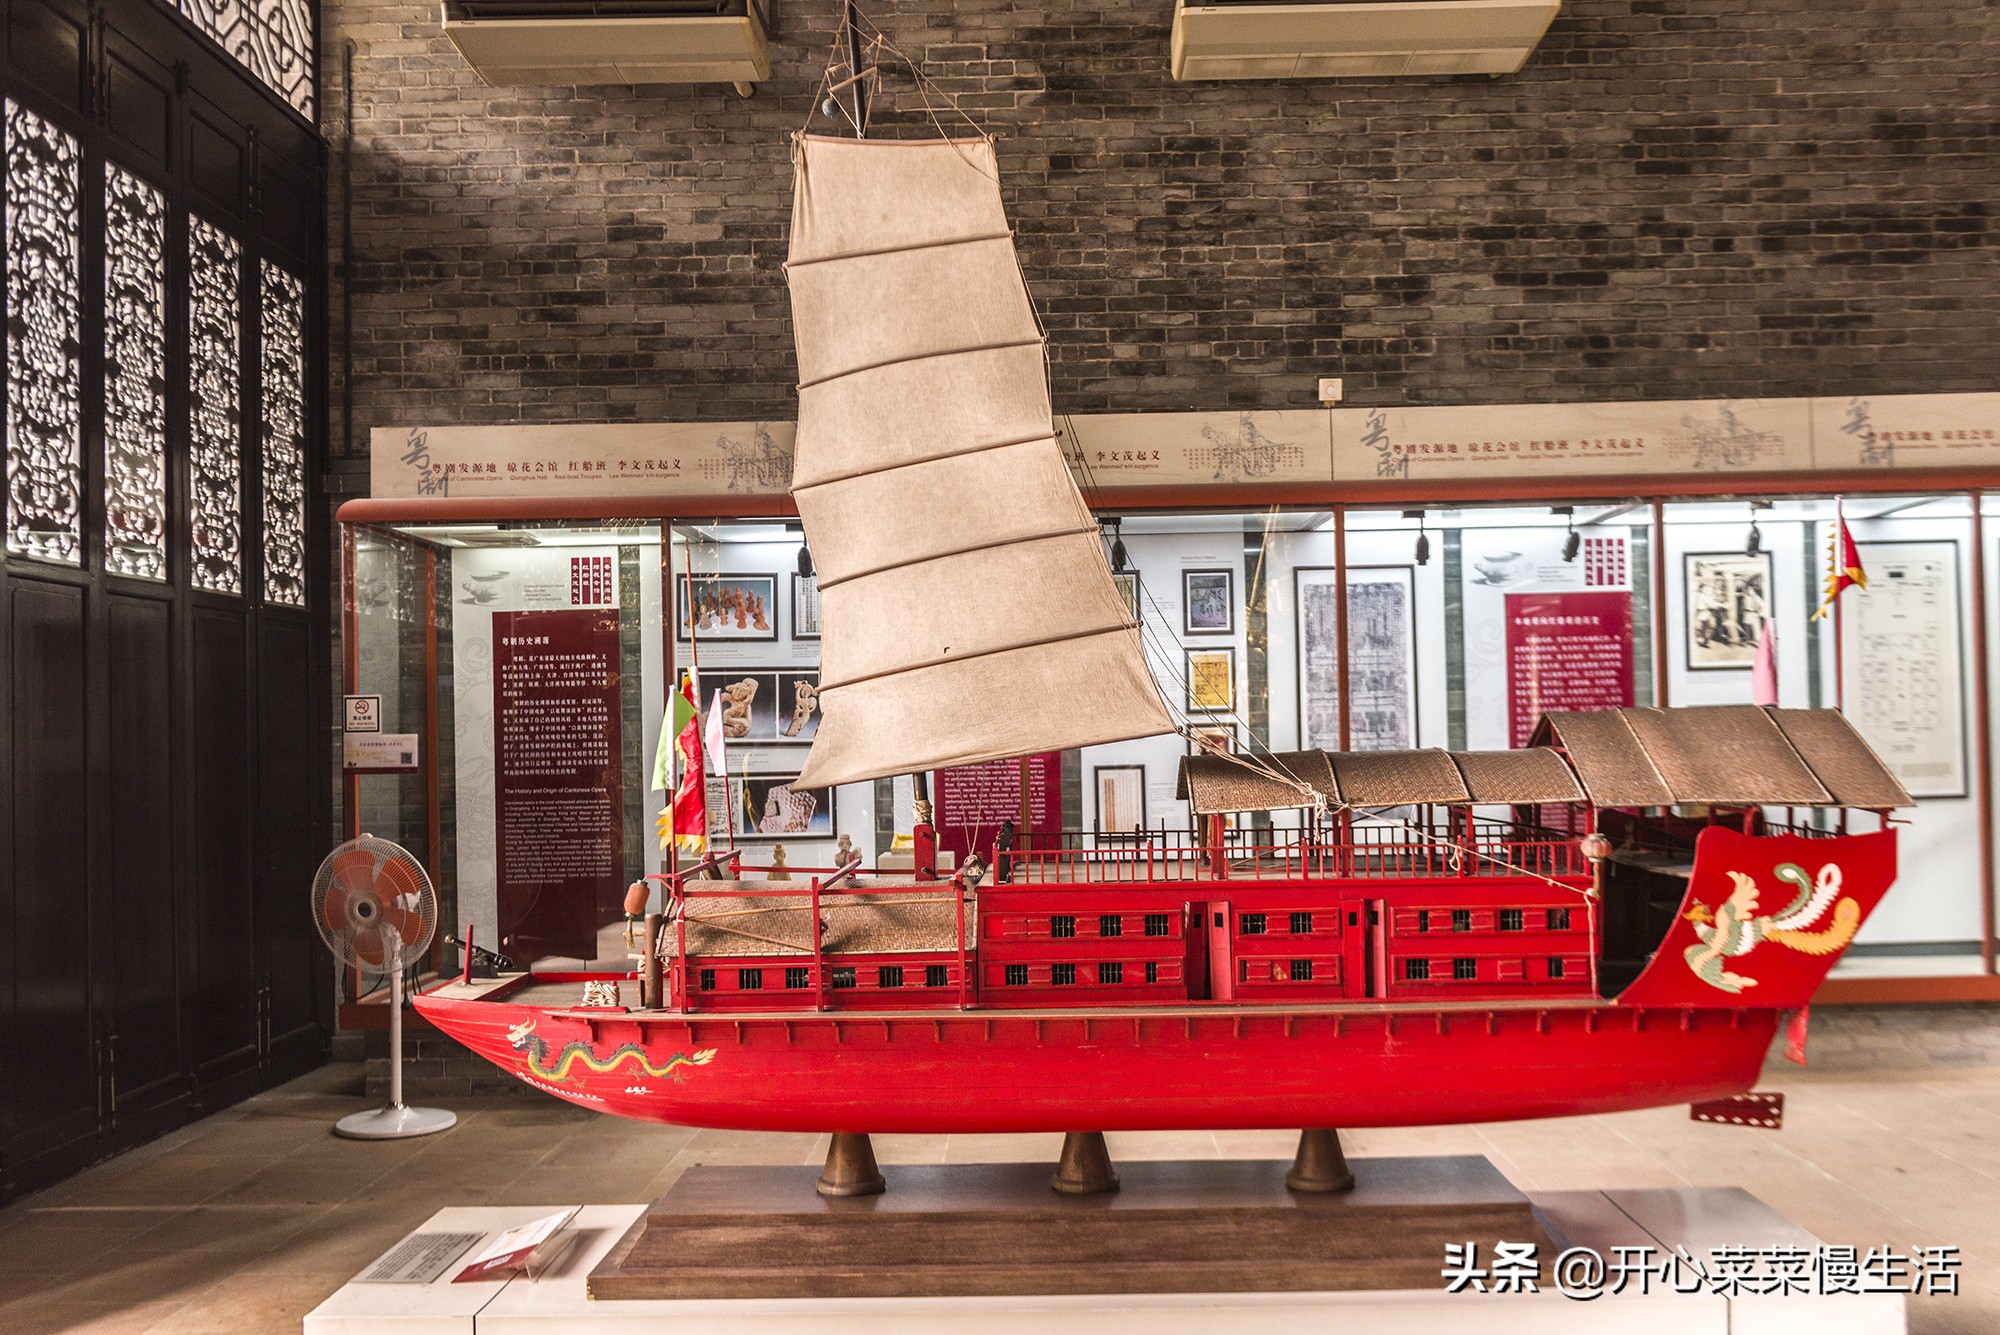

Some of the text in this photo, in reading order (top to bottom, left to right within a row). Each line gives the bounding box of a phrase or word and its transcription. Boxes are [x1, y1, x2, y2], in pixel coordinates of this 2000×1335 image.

[1096, 450, 1160, 462] 李文茂起义
[432, 459, 681, 474] 粤剧发源地 琼花会馆 红船班 李文茂起义
[543, 787, 558, 795] Origin
